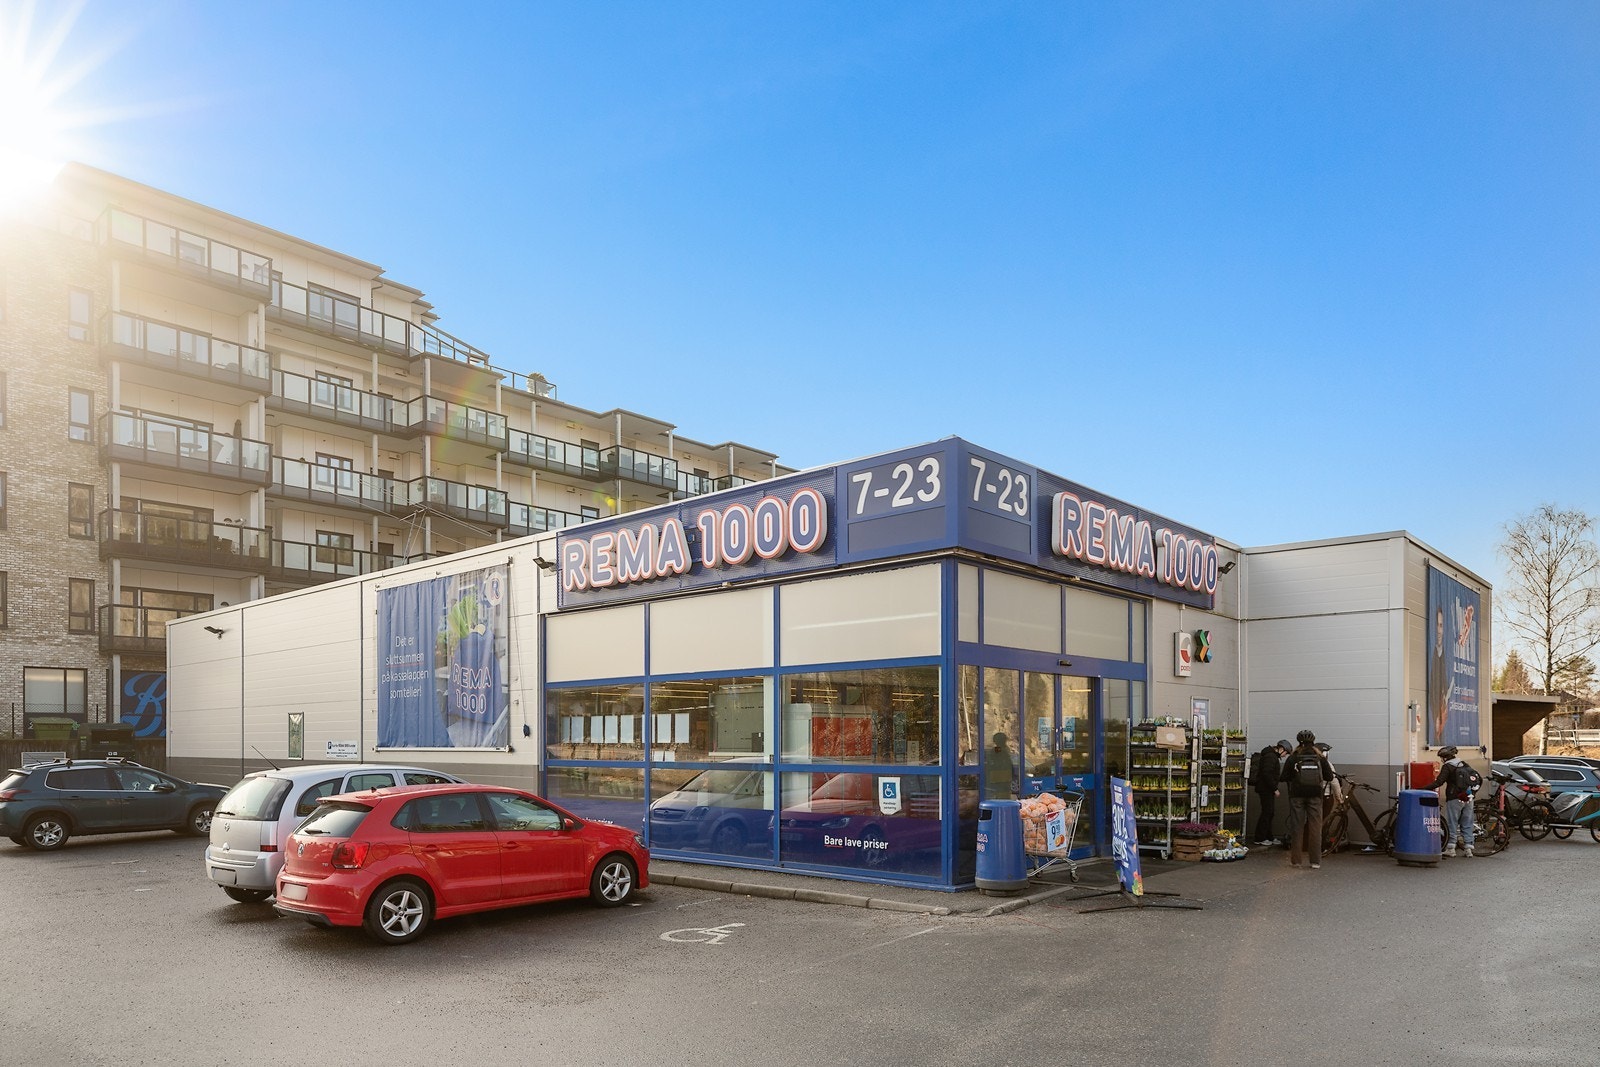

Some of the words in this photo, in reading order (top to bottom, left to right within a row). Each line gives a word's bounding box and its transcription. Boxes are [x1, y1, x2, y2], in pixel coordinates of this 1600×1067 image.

[852, 457, 942, 515] 7-23
[970, 457, 1028, 517] 7-23
[562, 517, 691, 592] REMA
[698, 487, 828, 568] 1000
[1054, 491, 1156, 579] REMA
[1156, 527, 1219, 595] 1000
[395, 635, 407, 647] Det
[408, 636, 415, 646] er
[452, 663, 492, 689] REMA
[390, 690, 403, 699] som
[455, 689, 487, 714] 1000
[824, 835, 843, 846] Bare
[845, 836, 862, 848] lave
[863, 838, 889, 850] priser
